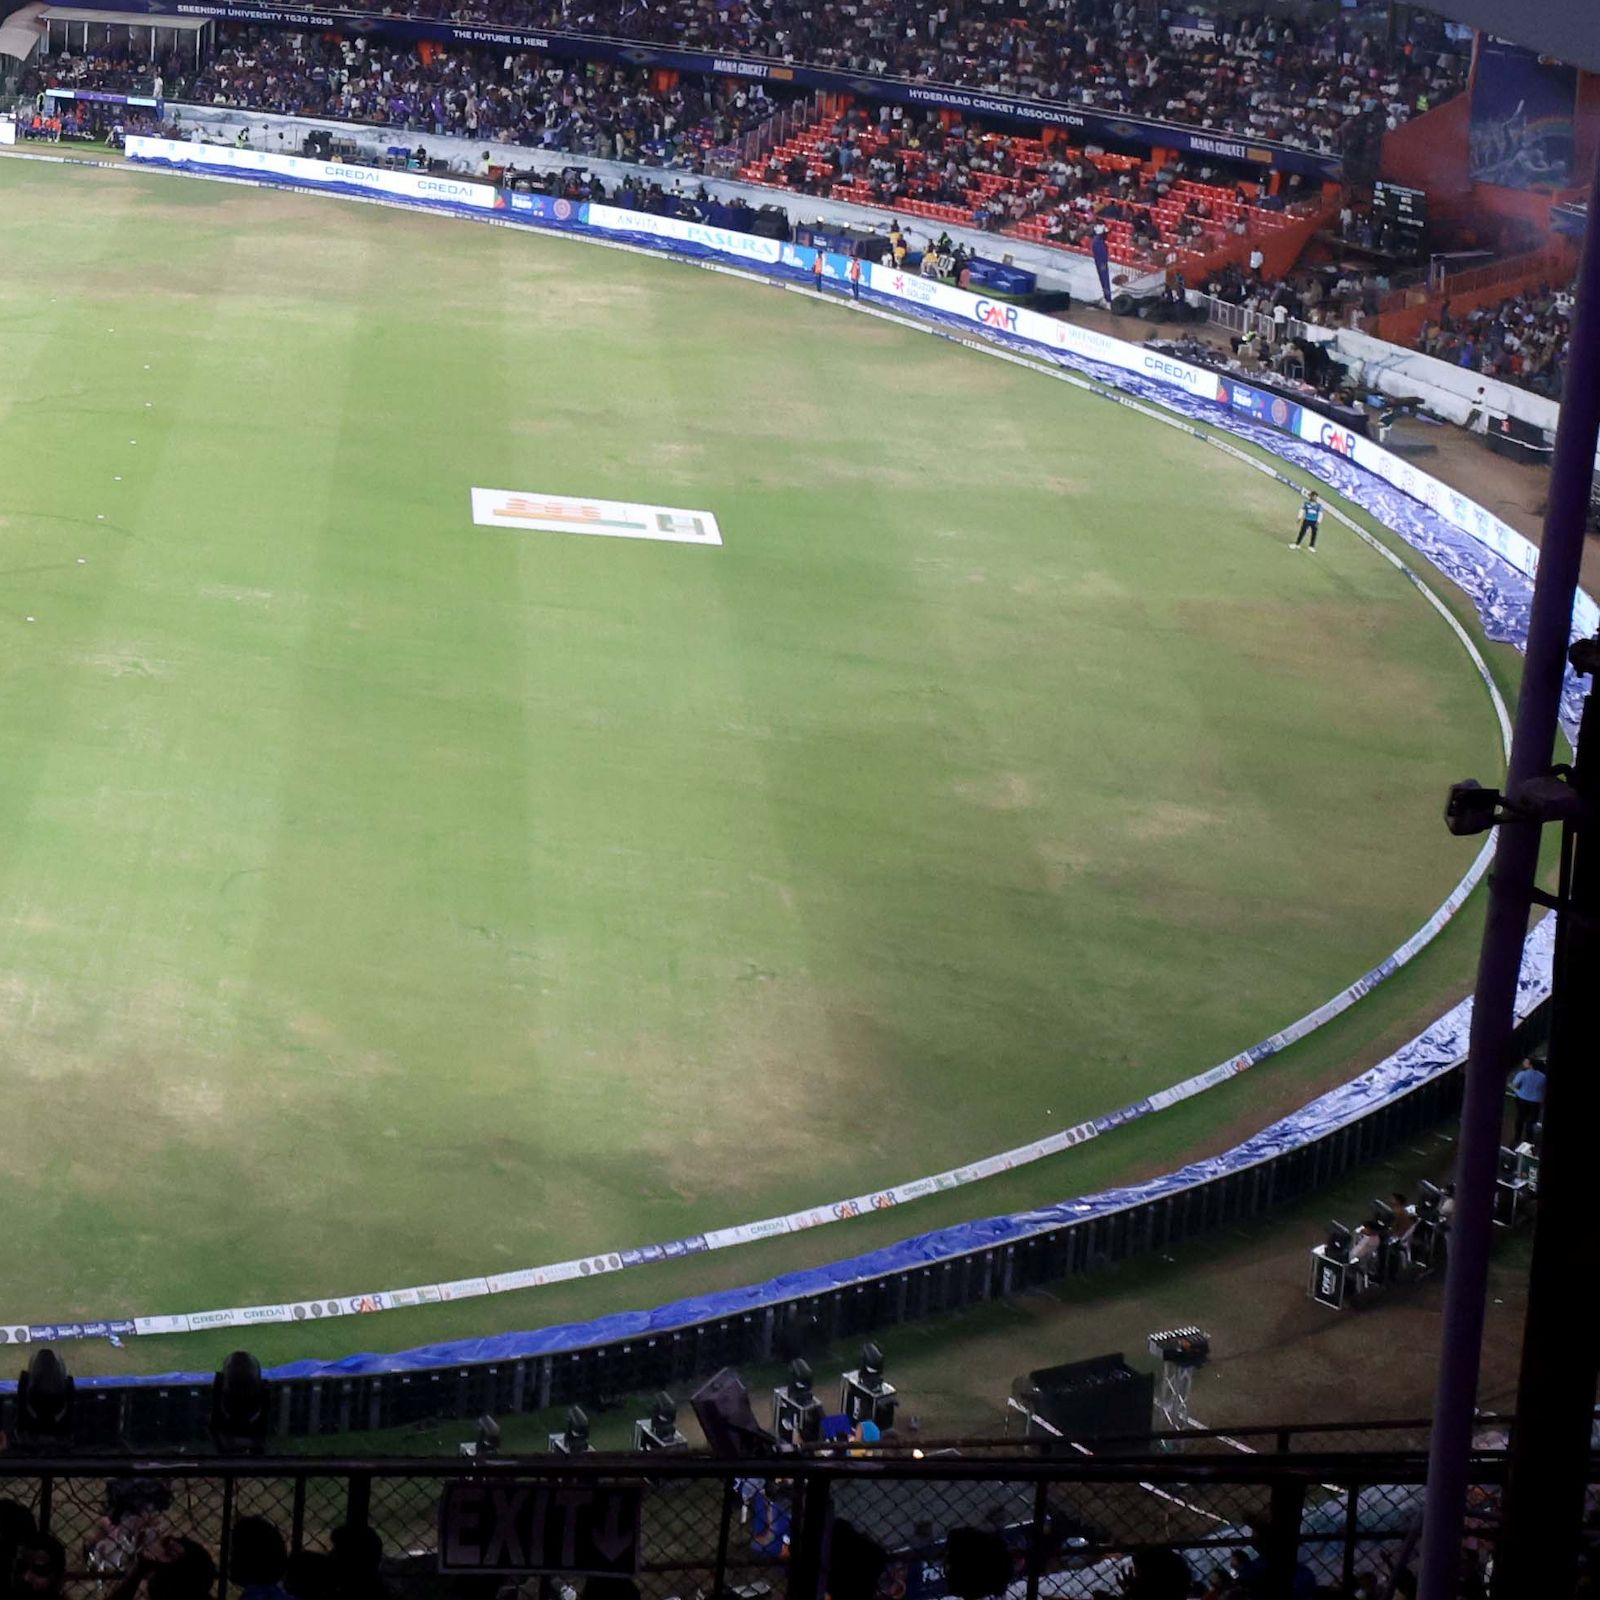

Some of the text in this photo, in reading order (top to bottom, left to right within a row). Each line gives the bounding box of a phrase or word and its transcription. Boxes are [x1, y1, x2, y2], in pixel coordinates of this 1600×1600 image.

[227, 8, 283, 20] UNIVERSITY
[283, 14, 309, 23] TG20
[452, 29, 549, 49] THE FUTURE IS HERE
[908, 88, 1085, 127] HYDERABAD CRICKET ASSOCIATION
[687, 227, 774, 257] PASURA
[447, 1487, 583, 1568] EXIT
